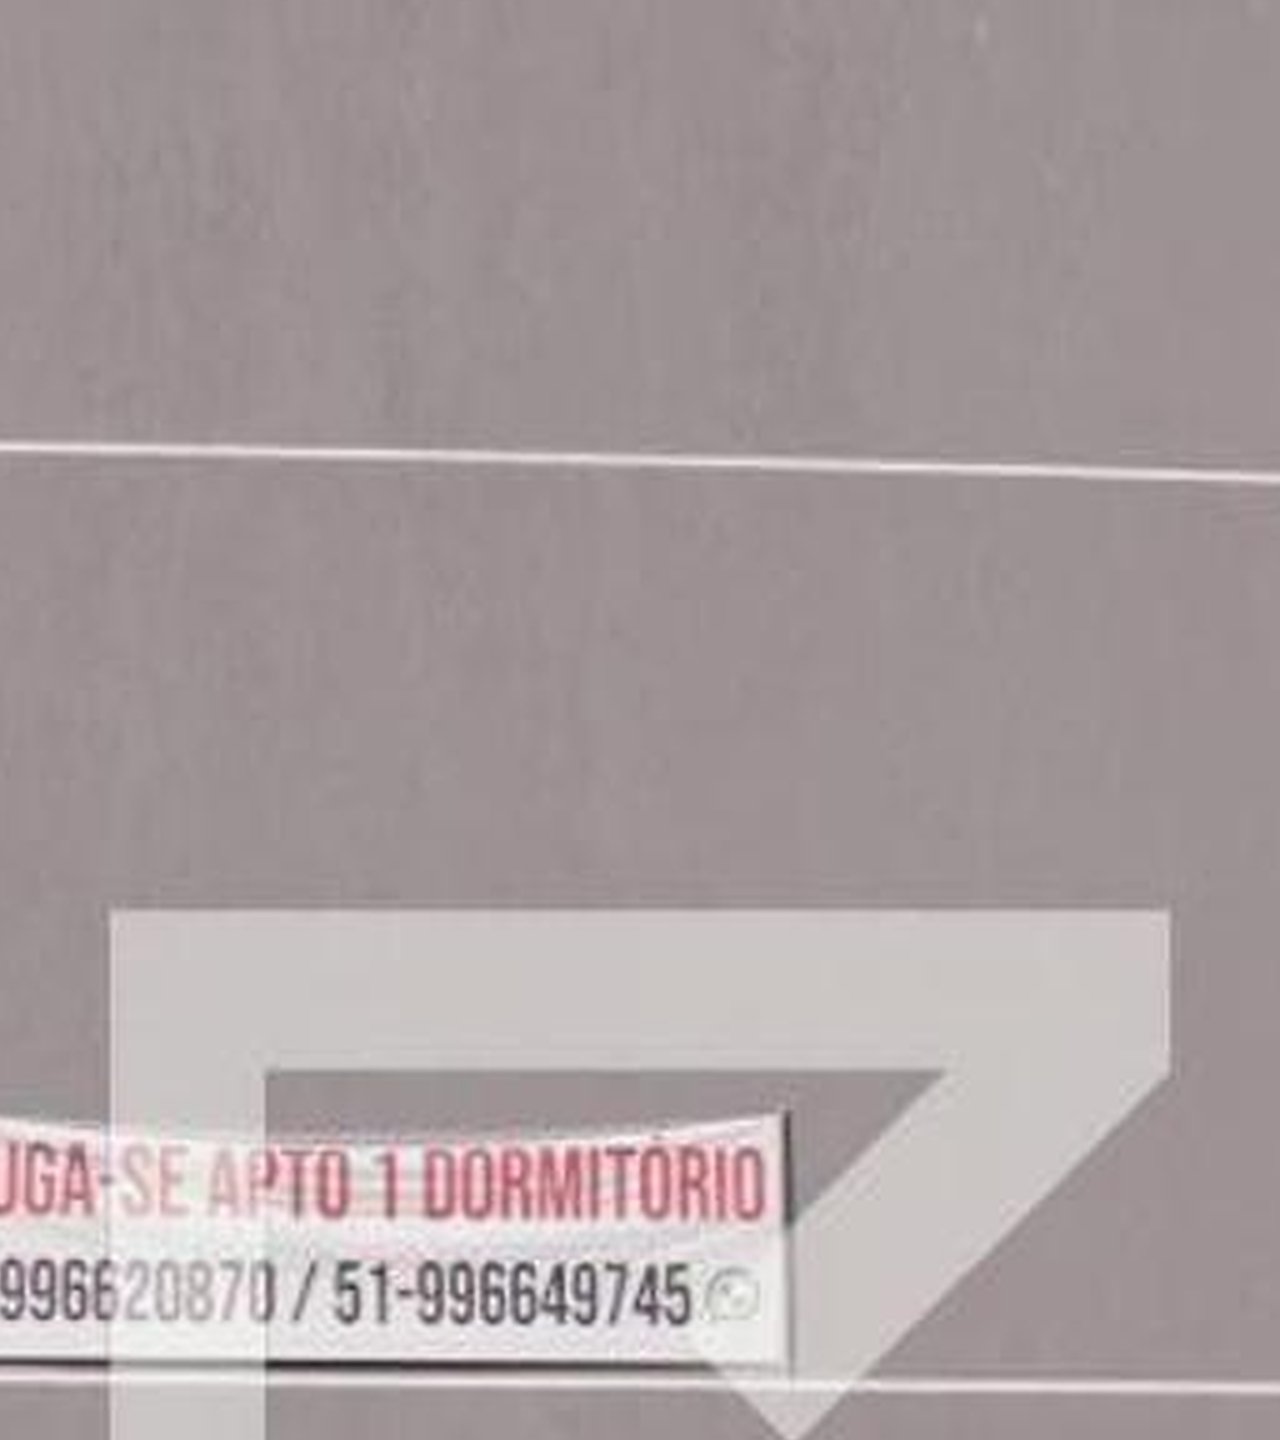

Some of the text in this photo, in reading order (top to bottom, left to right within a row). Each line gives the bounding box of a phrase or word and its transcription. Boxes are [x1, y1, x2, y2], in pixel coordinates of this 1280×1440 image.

[208, 1148, 350, 1219] APTO
[375, 1153, 398, 1219] 1
[292, 1263, 317, 1322] /
[334, 1261, 692, 1326] 51-996649745
